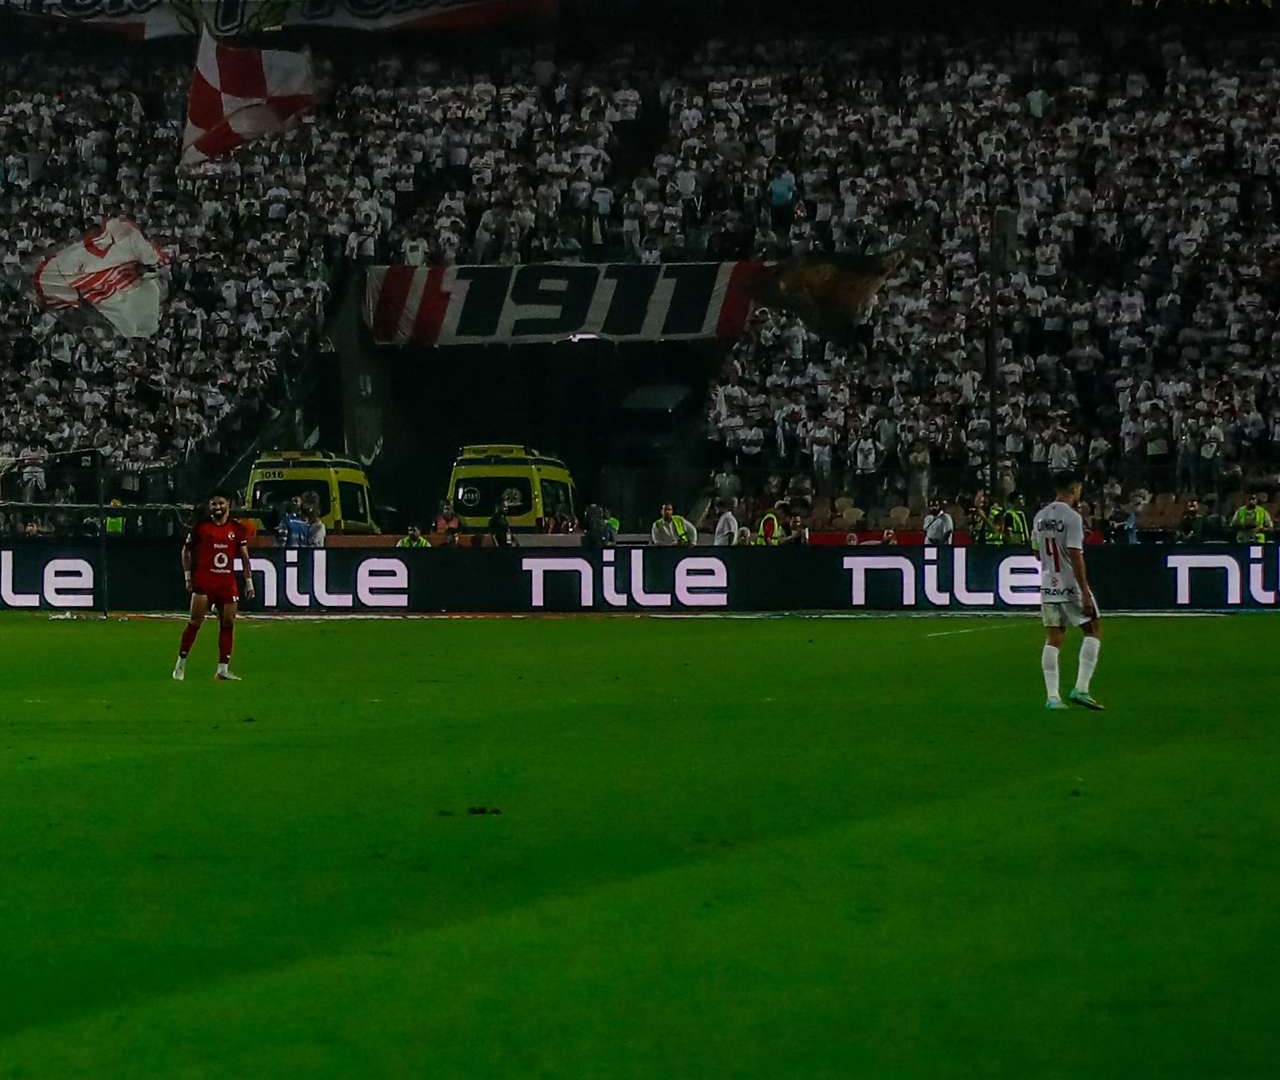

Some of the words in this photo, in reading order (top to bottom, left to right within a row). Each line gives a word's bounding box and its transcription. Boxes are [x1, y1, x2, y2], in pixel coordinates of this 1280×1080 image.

[444, 263, 728, 339] 1911
[521, 548, 729, 607] nile
[842, 547, 1041, 606] nile
